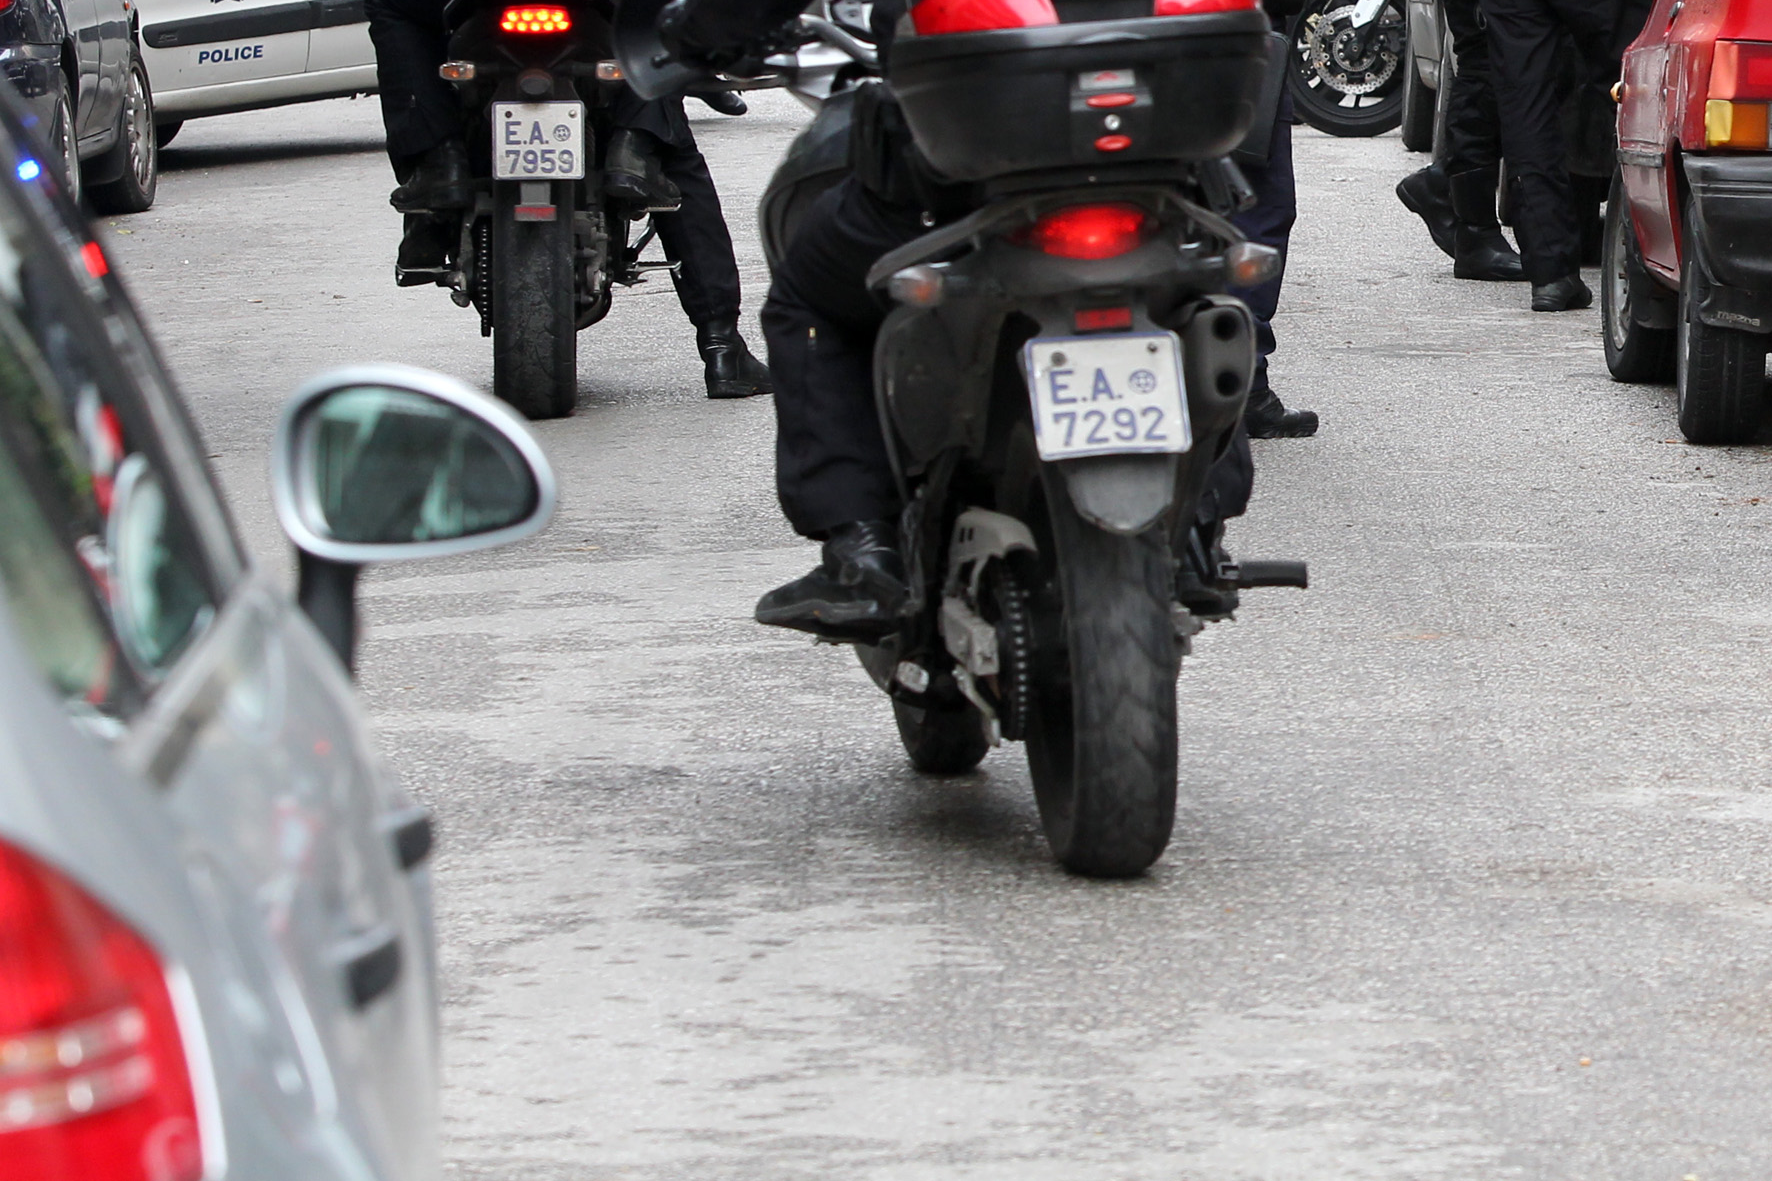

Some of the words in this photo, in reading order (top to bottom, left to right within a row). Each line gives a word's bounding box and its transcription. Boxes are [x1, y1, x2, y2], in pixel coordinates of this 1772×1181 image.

[198, 45, 264, 65] POLICE
[505, 149, 574, 174] 7959
[1053, 406, 1167, 447] 7292
